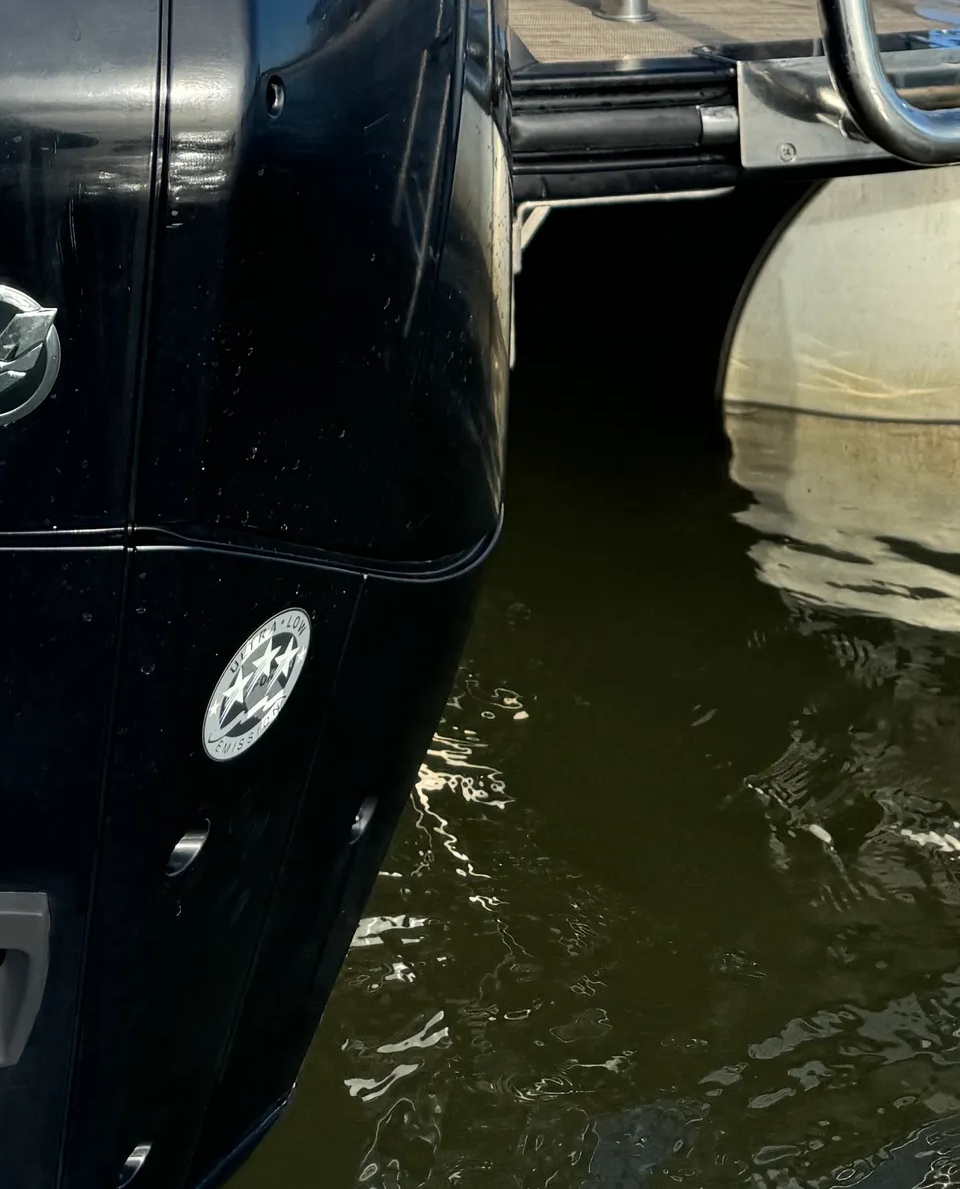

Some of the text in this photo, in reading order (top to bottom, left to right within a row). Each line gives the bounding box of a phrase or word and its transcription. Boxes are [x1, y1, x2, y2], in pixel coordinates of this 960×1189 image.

[229, 614, 307, 674] ULTRA LOW
[214, 700, 283, 754] EMISSION
